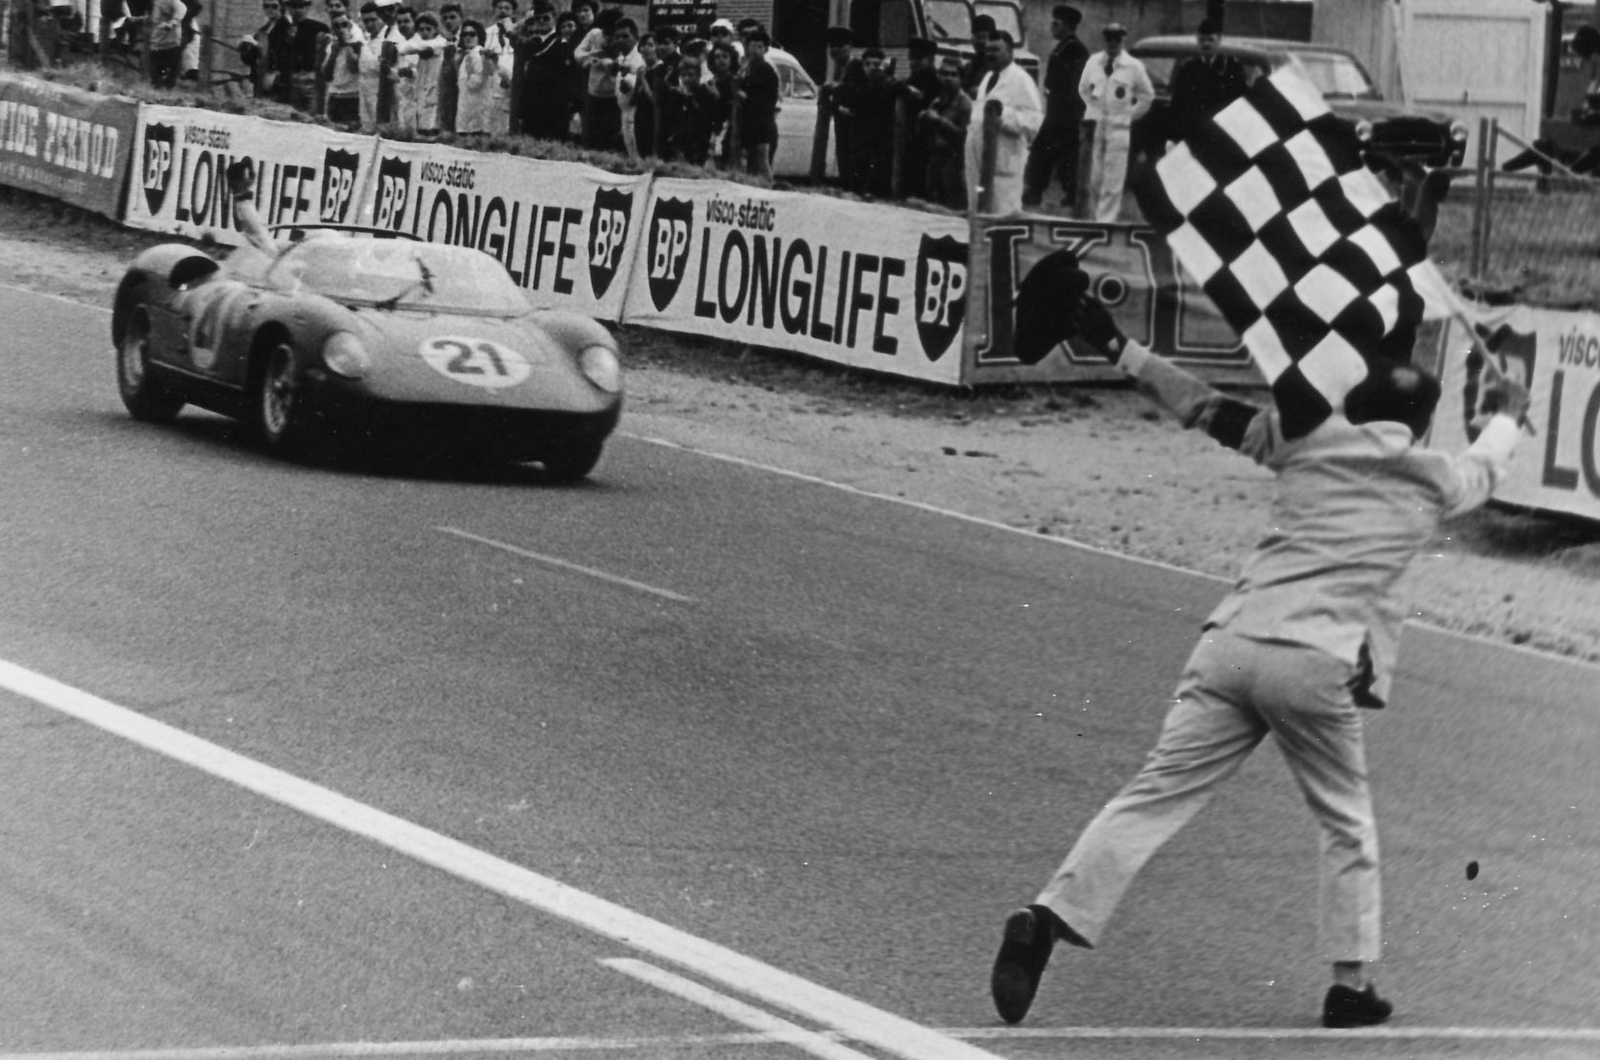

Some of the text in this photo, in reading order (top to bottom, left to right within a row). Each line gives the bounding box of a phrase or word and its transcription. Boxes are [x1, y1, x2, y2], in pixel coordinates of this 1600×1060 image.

[143, 139, 170, 189] BP
[421, 155, 475, 190] visco-static
[321, 165, 353, 222] BP
[375, 175, 407, 229] BP
[706, 193, 776, 232] visco-static
[590, 208, 626, 270] BP
[650, 218, 688, 280] BP
[694, 226, 906, 356] LONGLIFE
[920, 257, 967, 327] BP
[432, 340, 508, 376] 21
